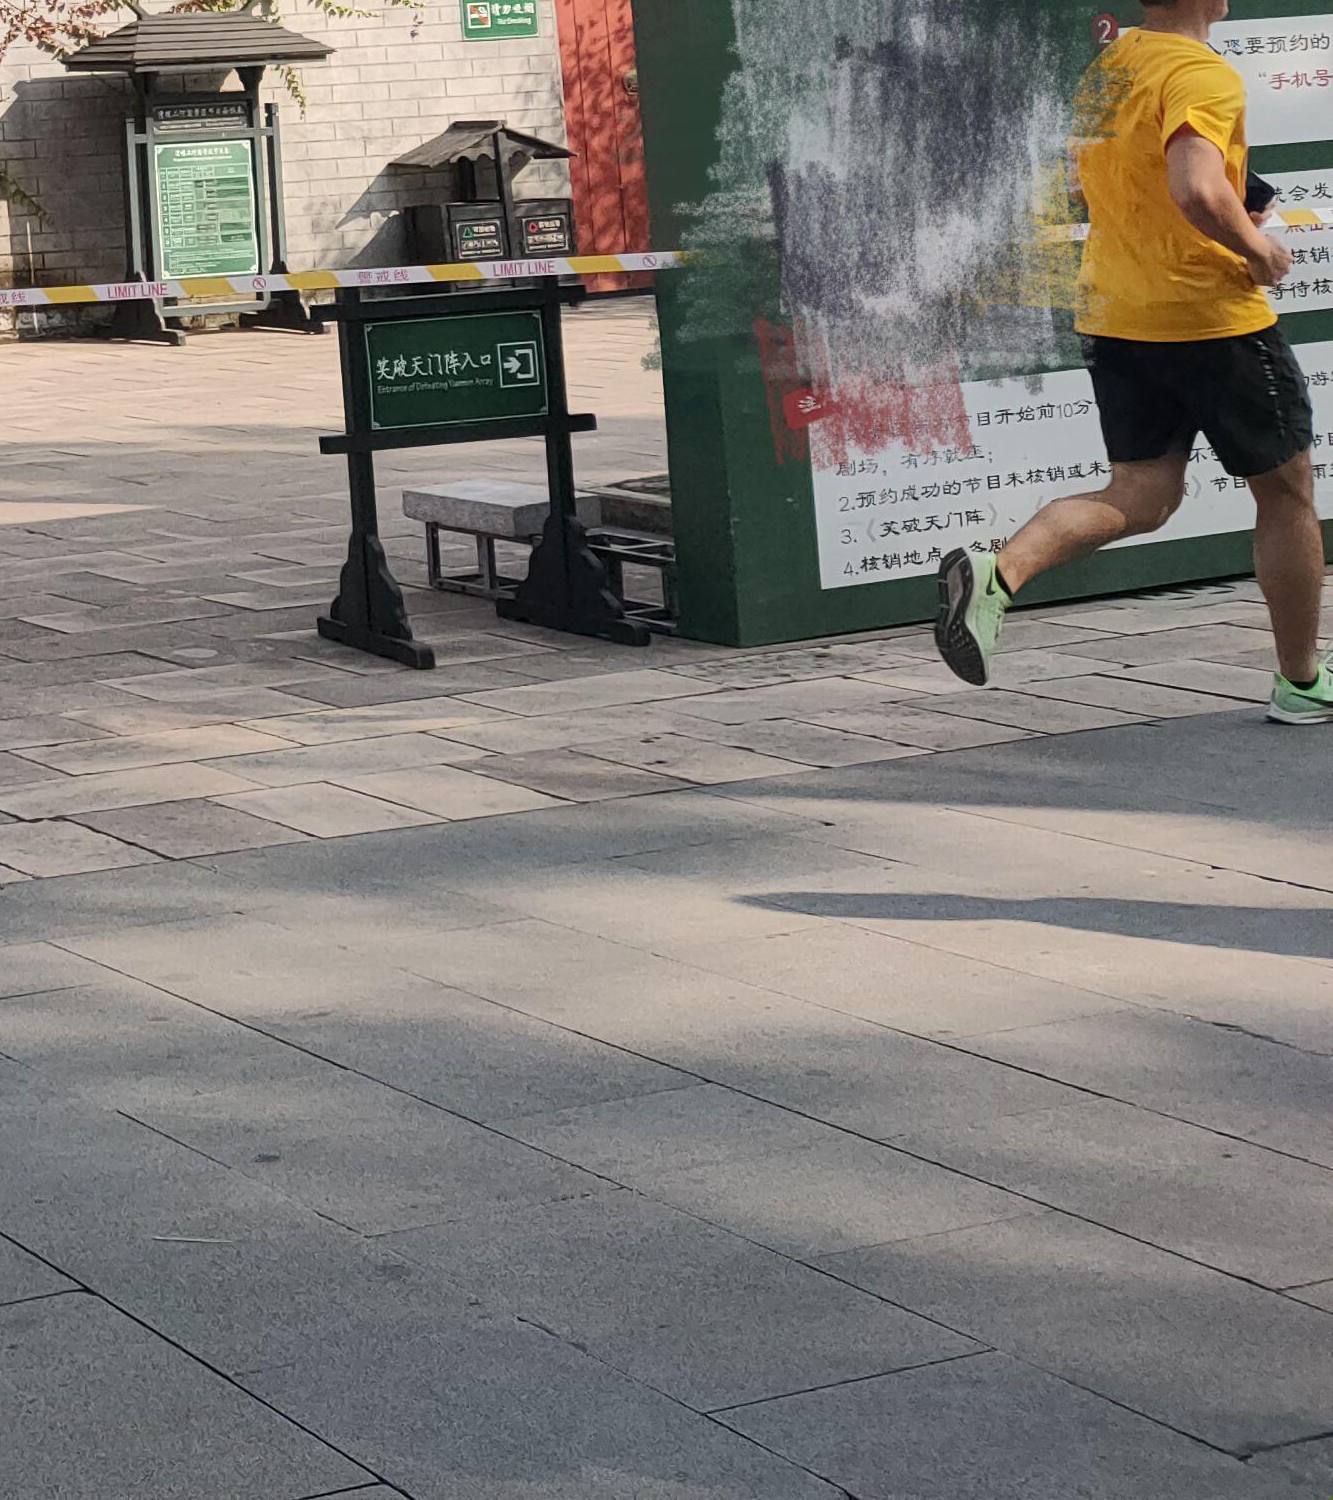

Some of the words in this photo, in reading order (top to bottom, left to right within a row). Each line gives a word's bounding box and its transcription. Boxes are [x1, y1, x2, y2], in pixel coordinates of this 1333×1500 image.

[1206, 32, 1330, 56] 您要预约的
[493, 263, 523, 277] LIMIT
[526, 260, 555, 274] LINE
[107, 284, 138, 299] LIMIT
[141, 282, 168, 297] LINE
[375, 350, 492, 380] 笑破天门阵入口
[838, 460, 1113, 513] 2.预约成功的节目未核销或未
